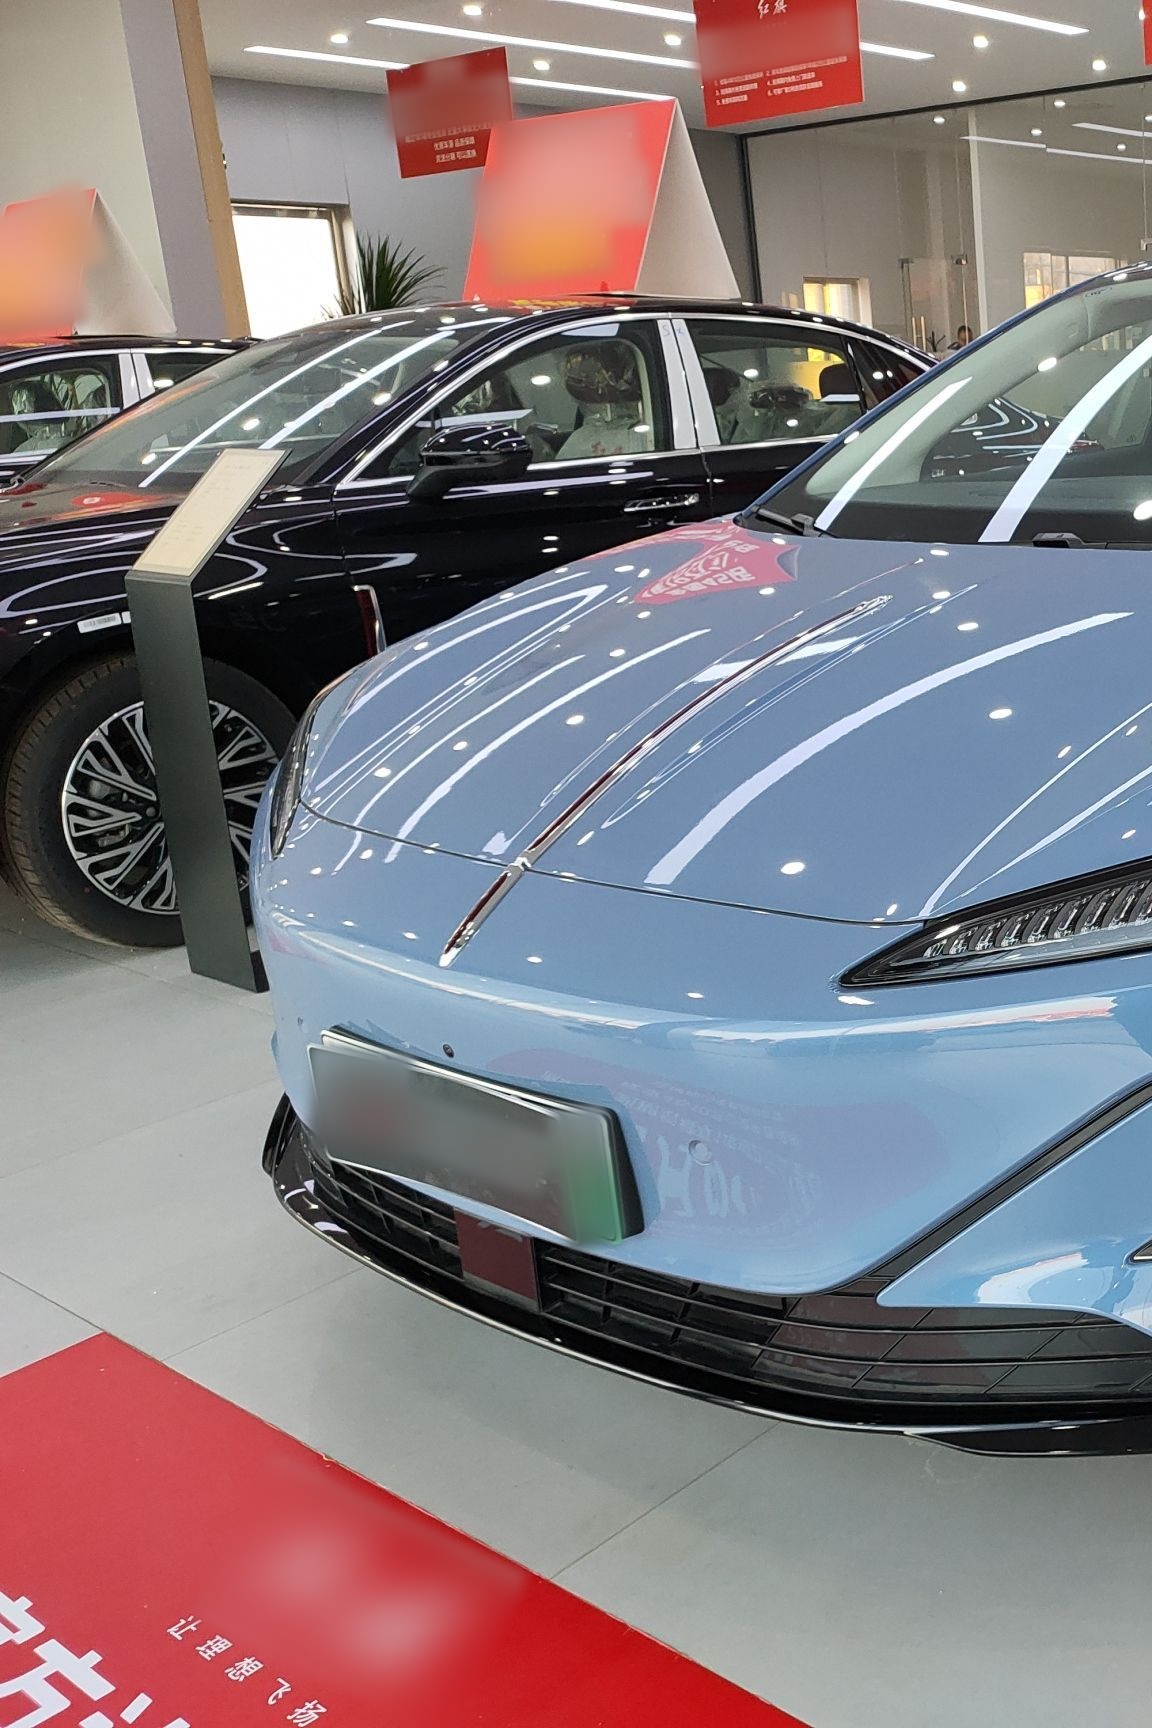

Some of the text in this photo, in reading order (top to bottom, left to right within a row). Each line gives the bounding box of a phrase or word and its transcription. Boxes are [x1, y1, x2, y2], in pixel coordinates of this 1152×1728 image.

[757, 0, 788, 19] 红旗
[166, 1615, 328, 1728] 让理想飞扬
